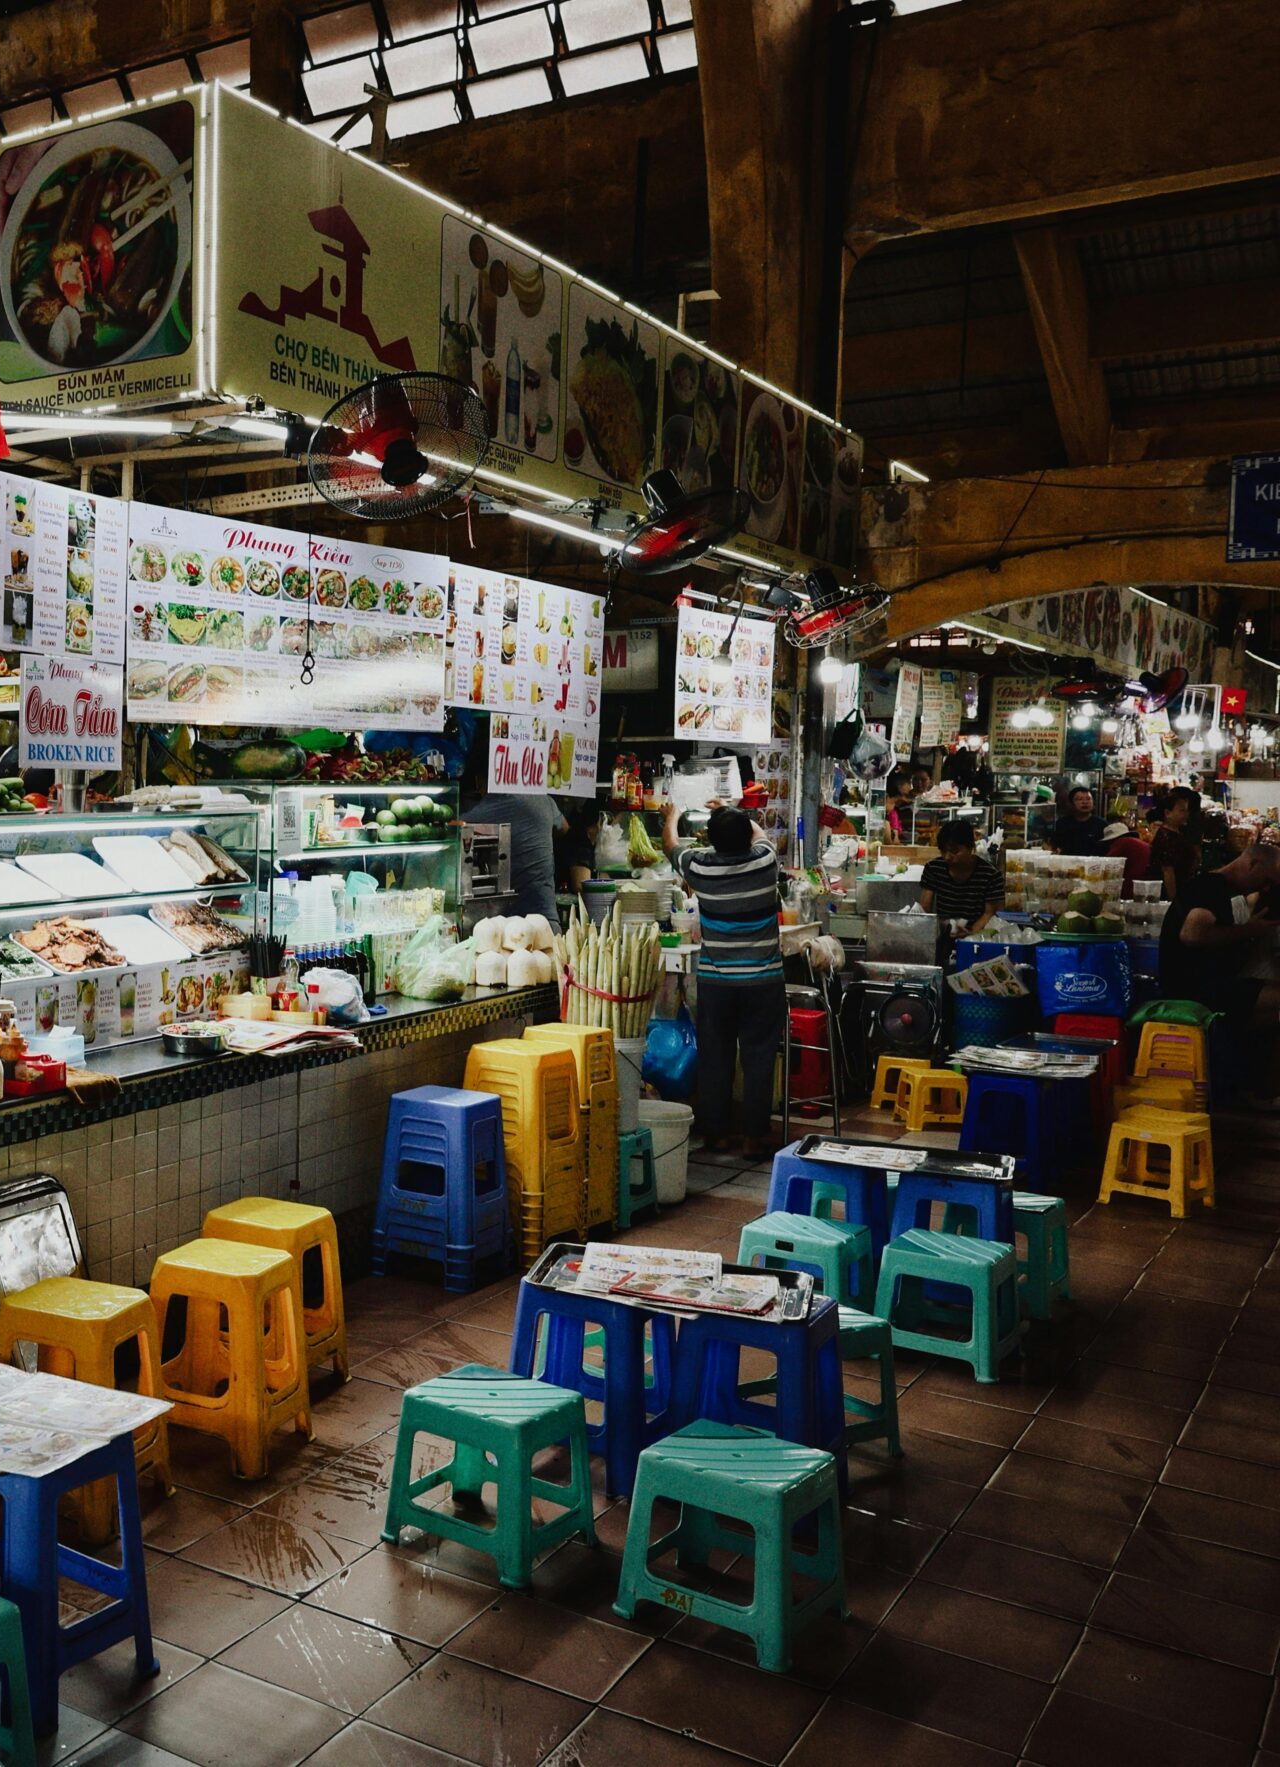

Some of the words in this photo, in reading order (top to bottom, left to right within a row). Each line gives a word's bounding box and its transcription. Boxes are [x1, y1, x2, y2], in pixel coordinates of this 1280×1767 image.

[274, 334, 308, 368] CHỢ
[344, 357, 388, 384] THÀN
[26, 393, 64, 409] SAUCE
[67, 386, 115, 406] NOODLE
[118, 373, 192, 397] VERMICELLI
[58, 373, 87, 392] BÚN
[299, 372, 340, 399] THÀNH
[498, 461, 516, 476] DRINK
[223, 528, 296, 559] Phụng
[628, 631, 652, 640] 1152
[50, 662, 84, 682] Phụng
[25, 686, 68, 734] Cơm
[74, 689, 118, 737] Tấm
[28, 743, 82, 762] BROKEN
[86, 745, 114, 762] RICE
[494, 744, 518, 786] Thu
[522, 746, 544, 786] Chè
